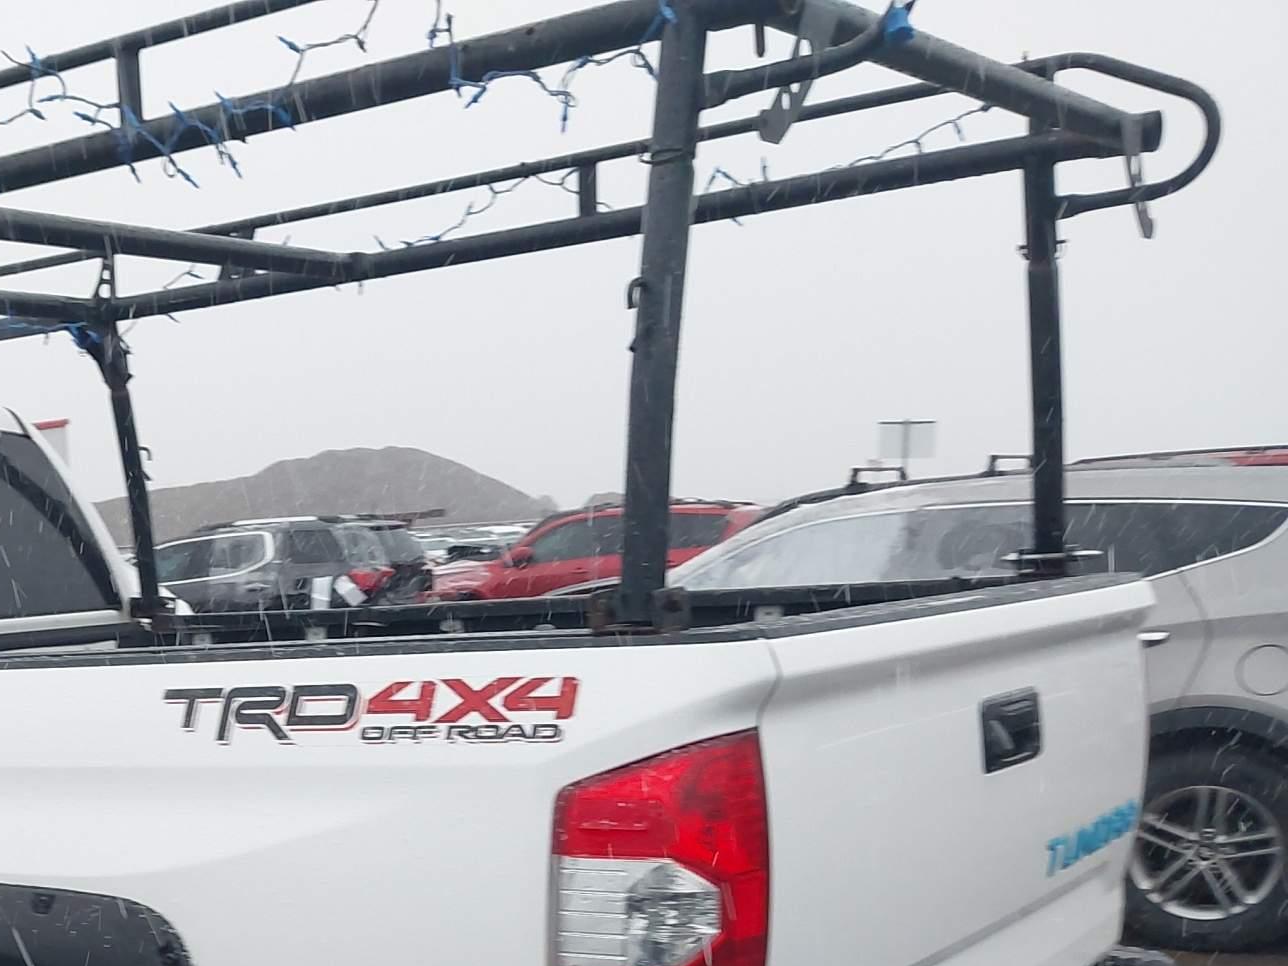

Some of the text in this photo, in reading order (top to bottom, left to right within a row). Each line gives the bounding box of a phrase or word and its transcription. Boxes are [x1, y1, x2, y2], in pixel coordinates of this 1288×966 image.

[164, 683, 360, 745] TRD
[360, 723, 563, 744] OFF ROAD
